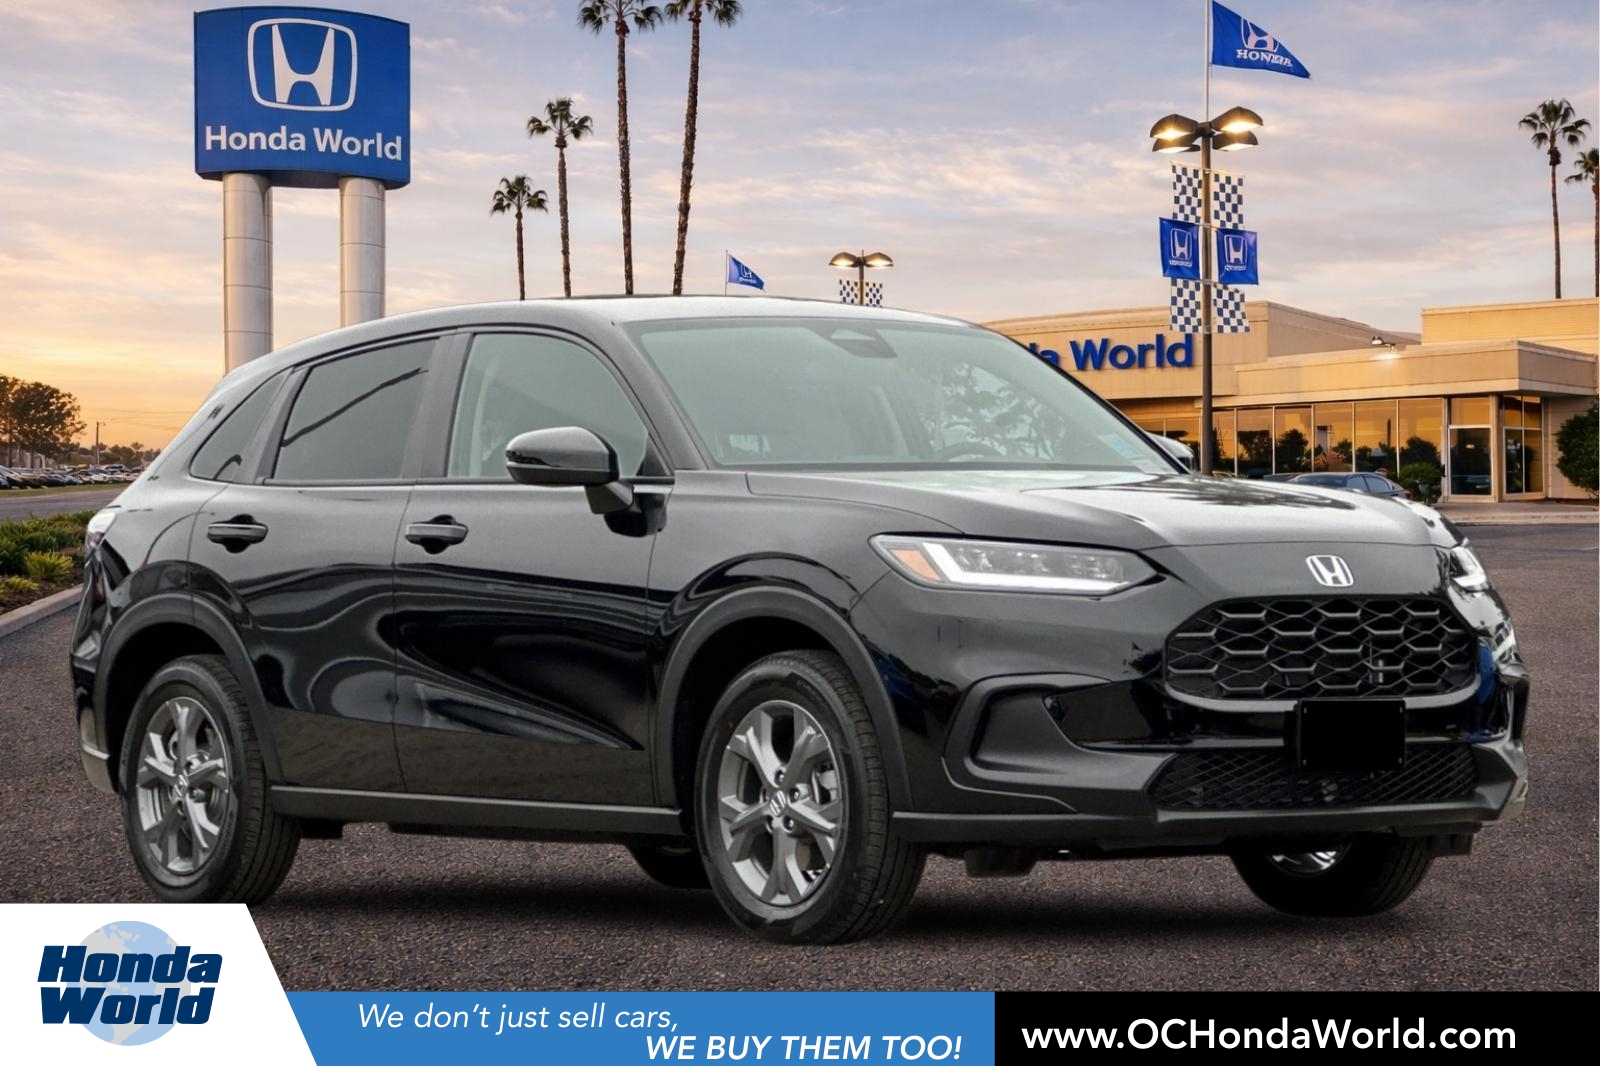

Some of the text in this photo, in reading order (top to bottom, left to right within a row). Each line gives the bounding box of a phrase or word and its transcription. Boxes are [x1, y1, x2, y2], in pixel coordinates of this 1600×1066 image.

[205, 125, 402, 160] Honda World
[1069, 333, 1194, 371] World
